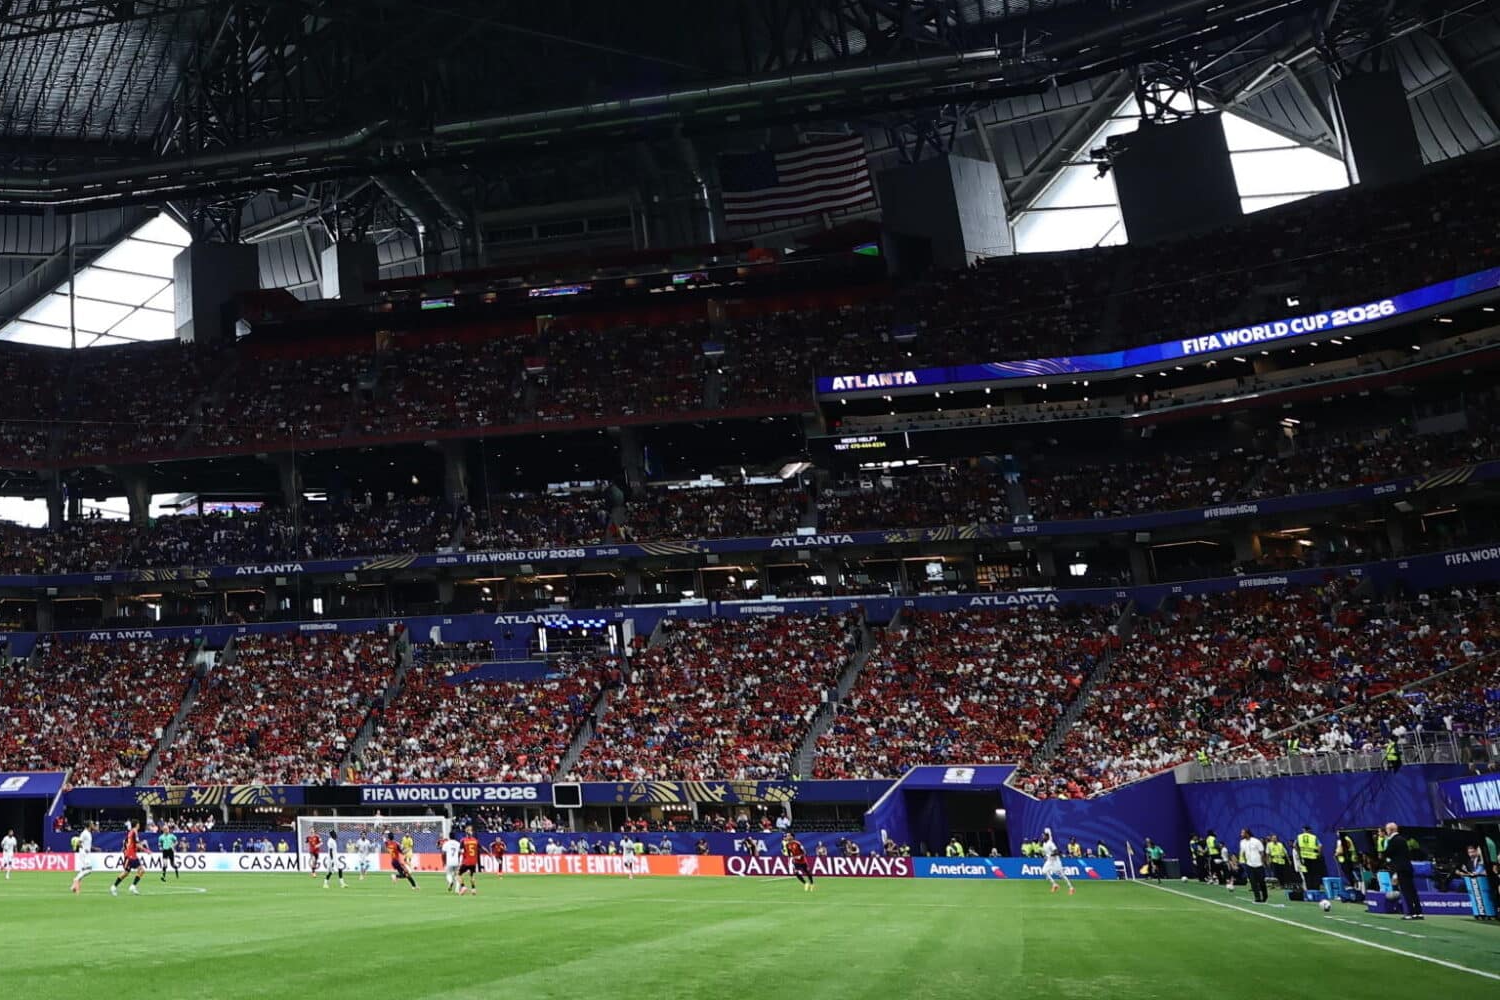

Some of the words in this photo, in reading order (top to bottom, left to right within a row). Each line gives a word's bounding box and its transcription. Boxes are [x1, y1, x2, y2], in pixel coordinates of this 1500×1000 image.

[1182, 337, 1221, 354] FIFA
[1221, 322, 1287, 347] WORLD
[1290, 313, 1329, 333] CUP
[1331, 299, 1397, 327] 2026
[832, 370, 918, 391] ATLANTA
[771, 534, 854, 547] ATLANTA
[466, 552, 488, 563] FIFA
[488, 551, 526, 562] WORLD
[527, 550, 548, 560] CUP
[549, 548, 586, 559] 2026
[1445, 552, 1470, 566] FIFA
[1470, 547, 1500, 563] WOR
[235, 563, 304, 575] ATLANTA
[970, 594, 1060, 606] ATLANTA
[494, 613, 570, 625] ATLANTA
[362, 787, 393, 801] FIFA
[395, 787, 449, 801] WORLD
[451, 787, 481, 800] CUP
[483, 786, 538, 800] 2026
[734, 839, 768, 852] FA
[104, 855, 206, 870] CAAMGOS
[519, 855, 561, 873] DEPOT
[564, 855, 584, 873] TE
[812, 856, 908, 876] AIRWAYS
[930, 863, 986, 875] American
[1021, 864, 1080, 876] Aman
